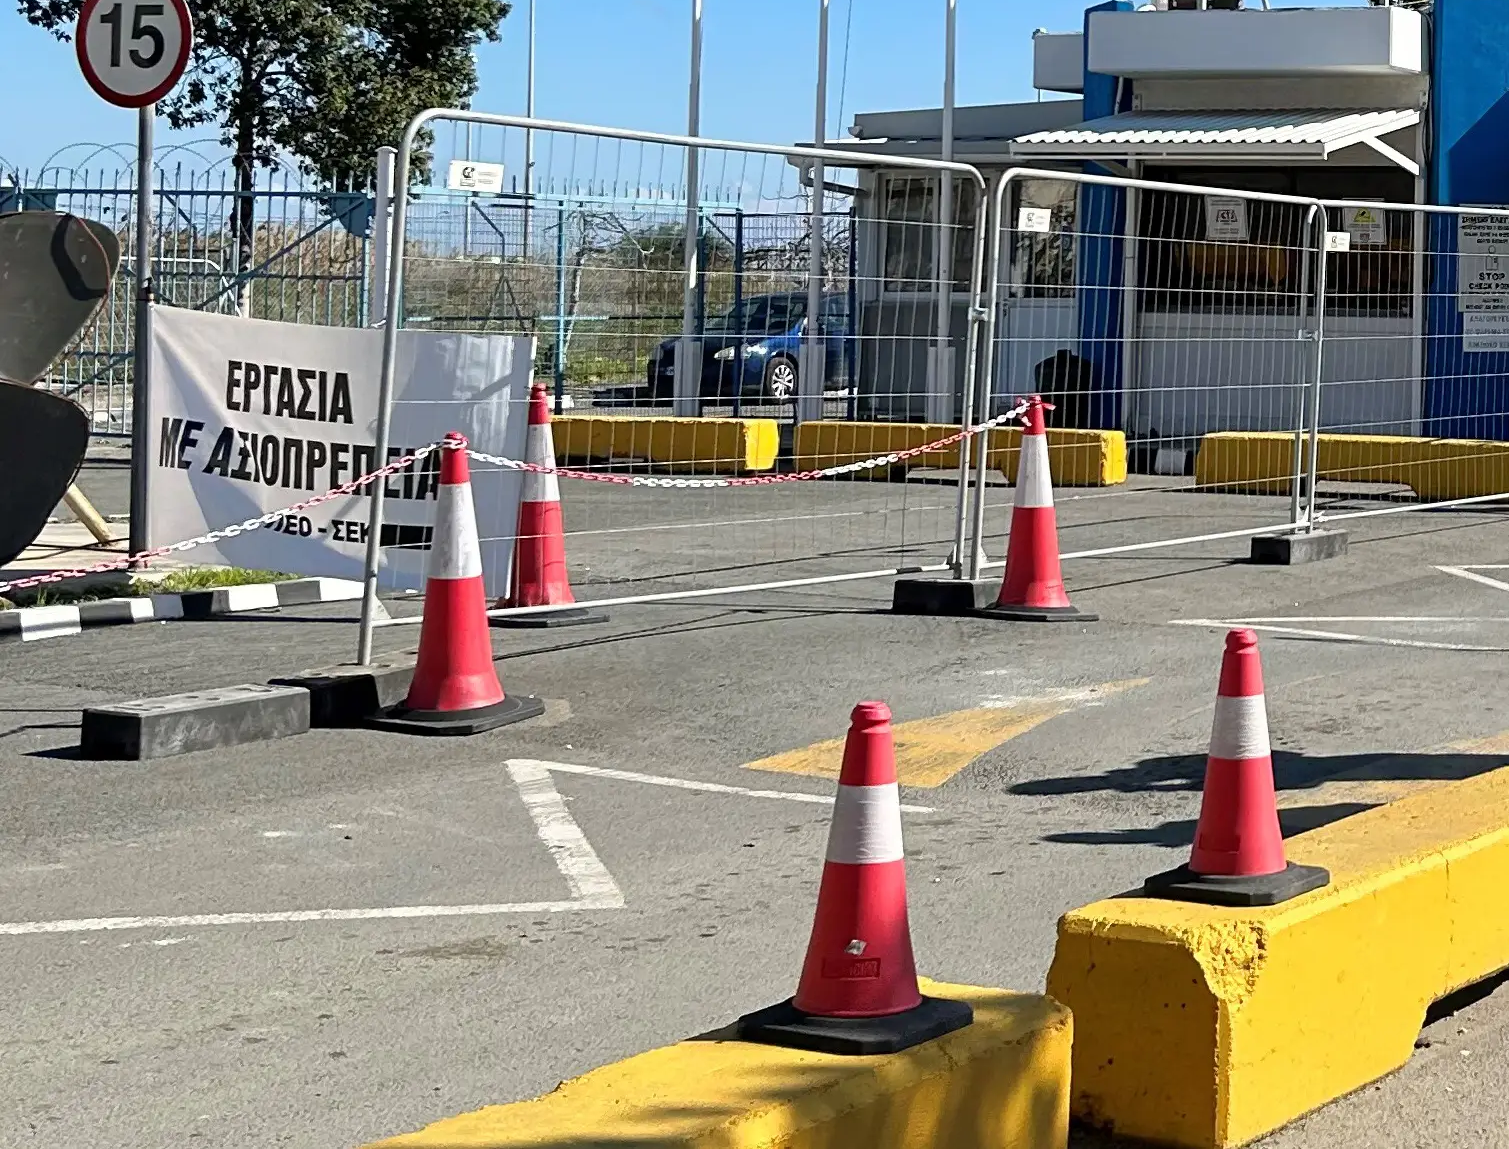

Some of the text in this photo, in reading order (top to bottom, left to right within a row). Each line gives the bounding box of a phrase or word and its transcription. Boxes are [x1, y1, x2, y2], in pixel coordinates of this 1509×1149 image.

[100, 3, 165, 69] 15
[1478, 272, 1506, 281] STOP
[226, 359, 354, 425] ΕΡΓΑΣΙΑ
[159, 417, 205, 470] ΜΕ
